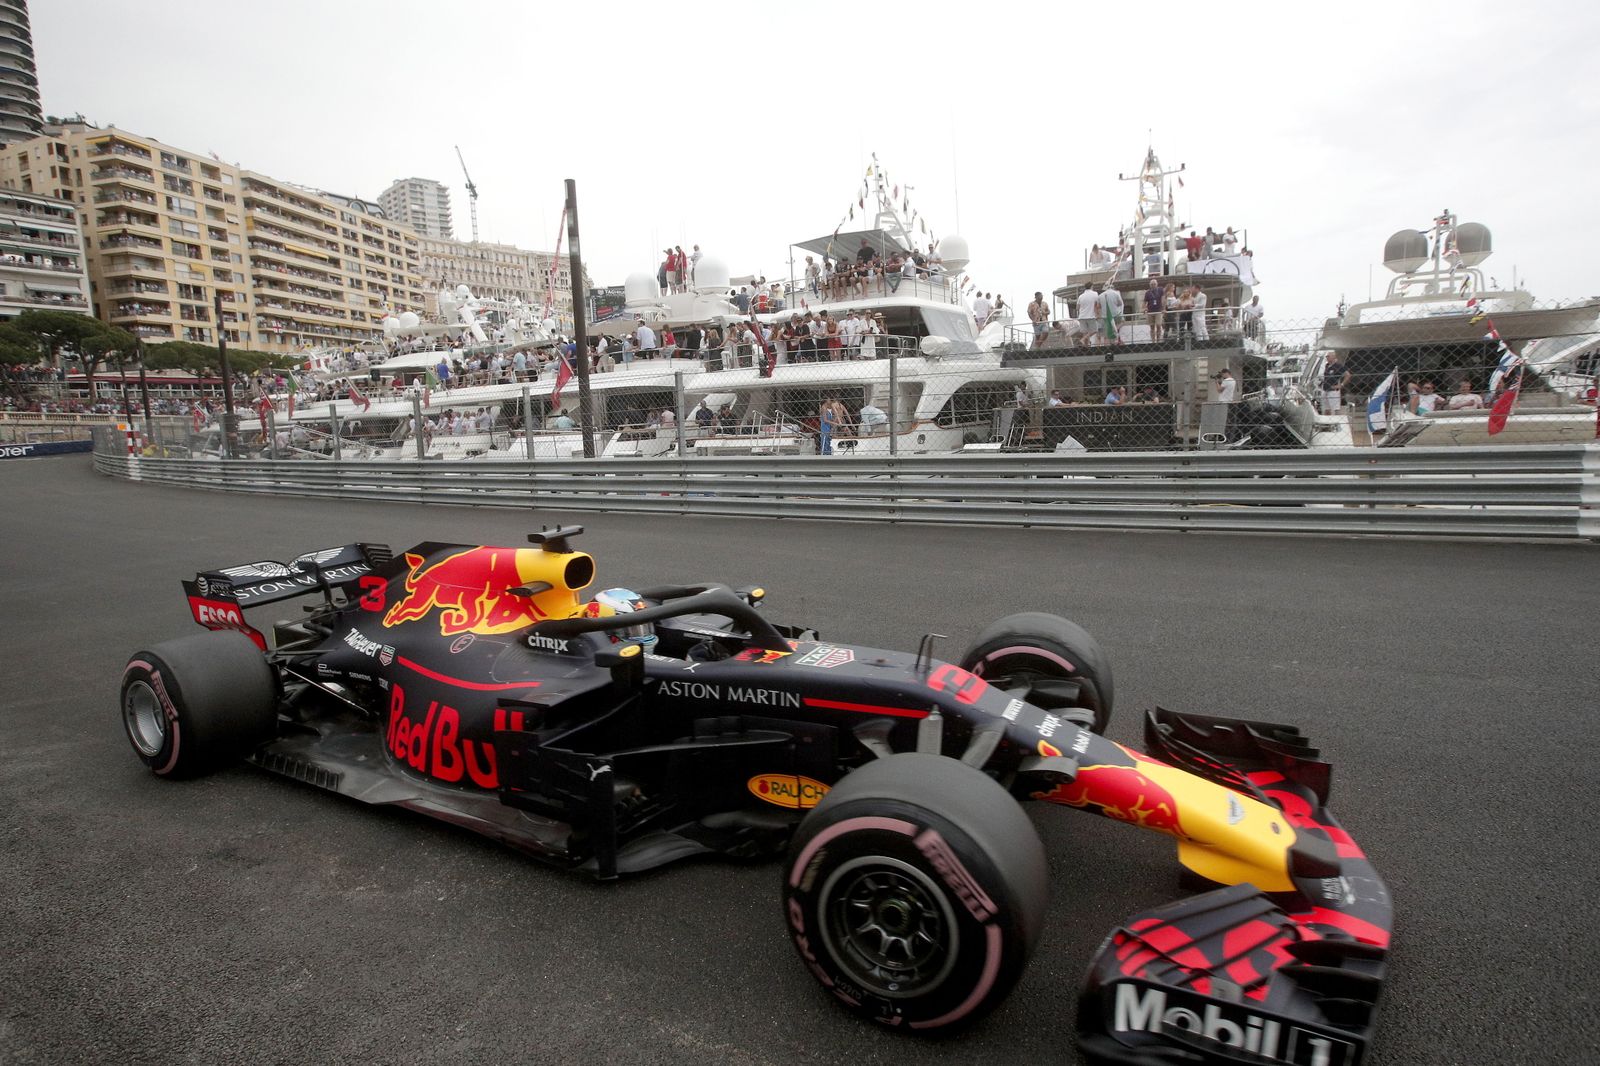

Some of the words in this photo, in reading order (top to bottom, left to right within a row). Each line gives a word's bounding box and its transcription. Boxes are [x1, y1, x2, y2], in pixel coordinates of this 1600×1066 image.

[233, 579, 297, 600] STON
[296, 563, 372, 585] MRTIN
[359, 576, 388, 612] 3
[657, 680, 720, 699] ASTON
[727, 685, 800, 708] MARTIN
[771, 781, 826, 800] RAUCH
[1114, 983, 1281, 1059] Mobil
